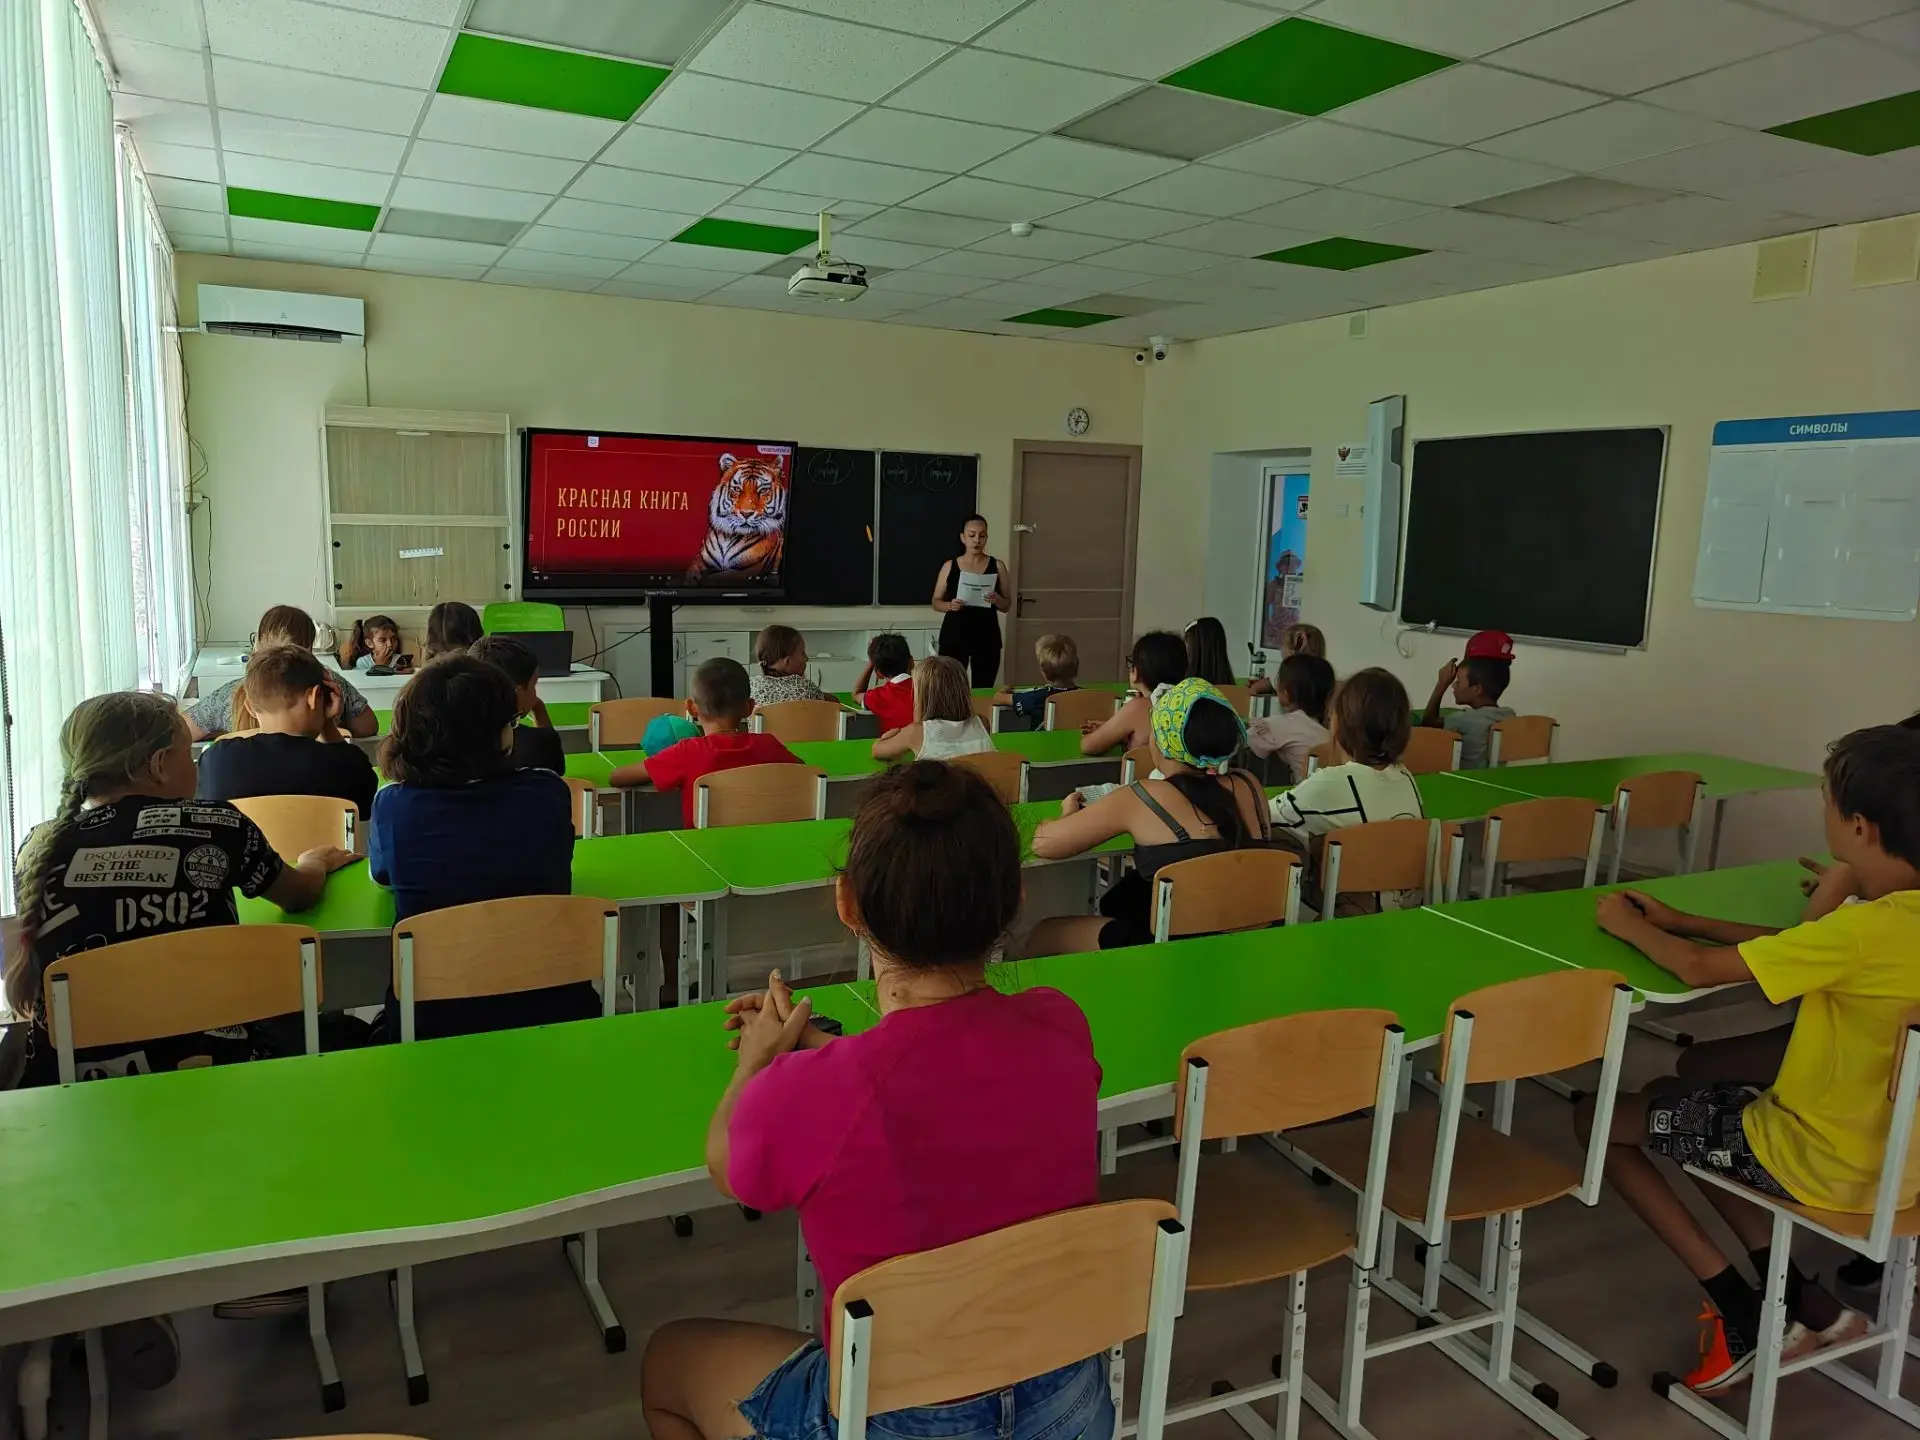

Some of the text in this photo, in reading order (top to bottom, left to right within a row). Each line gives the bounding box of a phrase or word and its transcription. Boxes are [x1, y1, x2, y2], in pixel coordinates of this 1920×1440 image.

[1789, 422, 1848, 435] СИМВОЛЫ
[557, 487, 689, 511] КРАСНАЯ КНИГА
[556, 518, 621, 539] РОССИИ
[84, 849, 176, 861] DSQUARED2
[92, 860, 142, 871] IS THE
[74, 872, 168, 884] BEST BREAK
[116, 889, 209, 933] DSQ2
